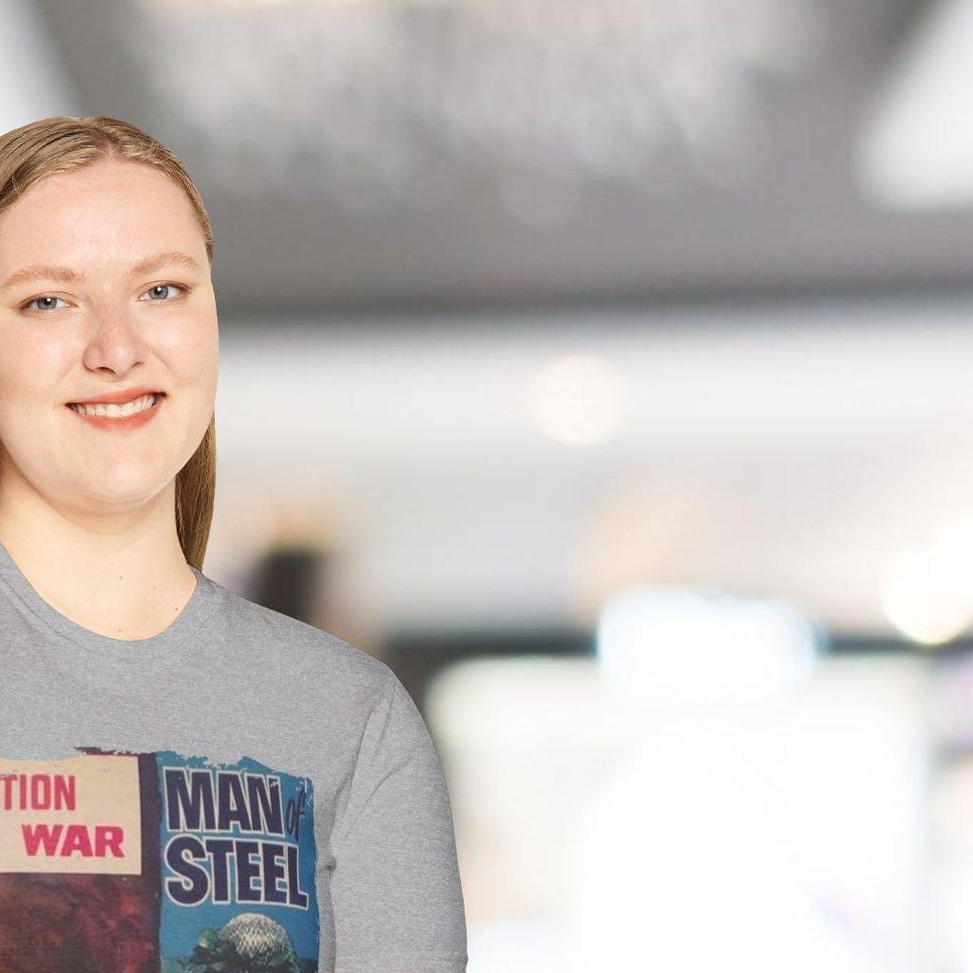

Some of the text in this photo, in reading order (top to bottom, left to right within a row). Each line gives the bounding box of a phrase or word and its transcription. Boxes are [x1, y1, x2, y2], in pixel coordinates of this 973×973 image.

[21, 823, 125, 858] WAR
[163, 766, 307, 842] MAN of
[164, 834, 309, 910] STEEL
